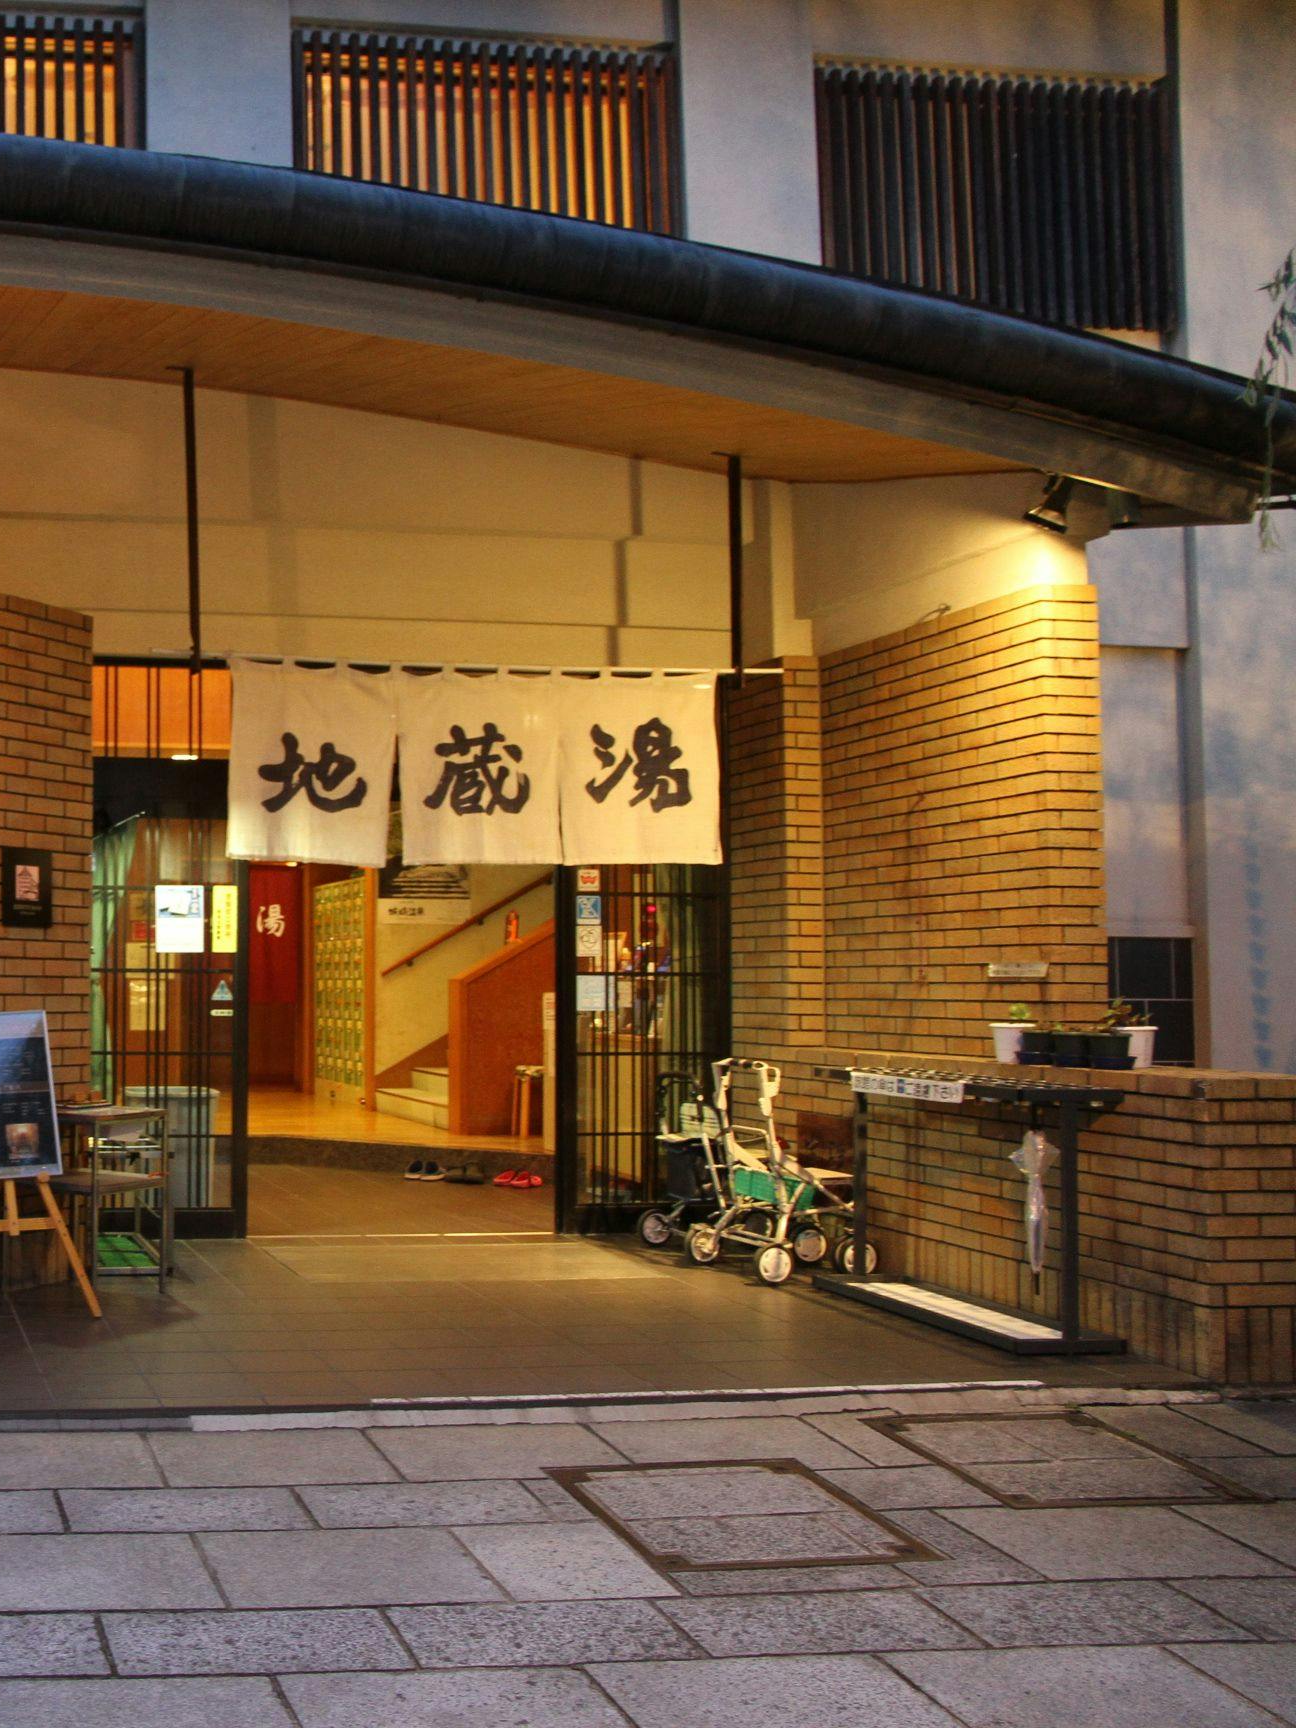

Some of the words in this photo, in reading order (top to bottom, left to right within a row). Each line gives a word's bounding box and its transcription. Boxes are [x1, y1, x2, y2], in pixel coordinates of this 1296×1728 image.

[258, 717, 693, 816] 地蔵湯
[256, 904, 285, 937] 湯
